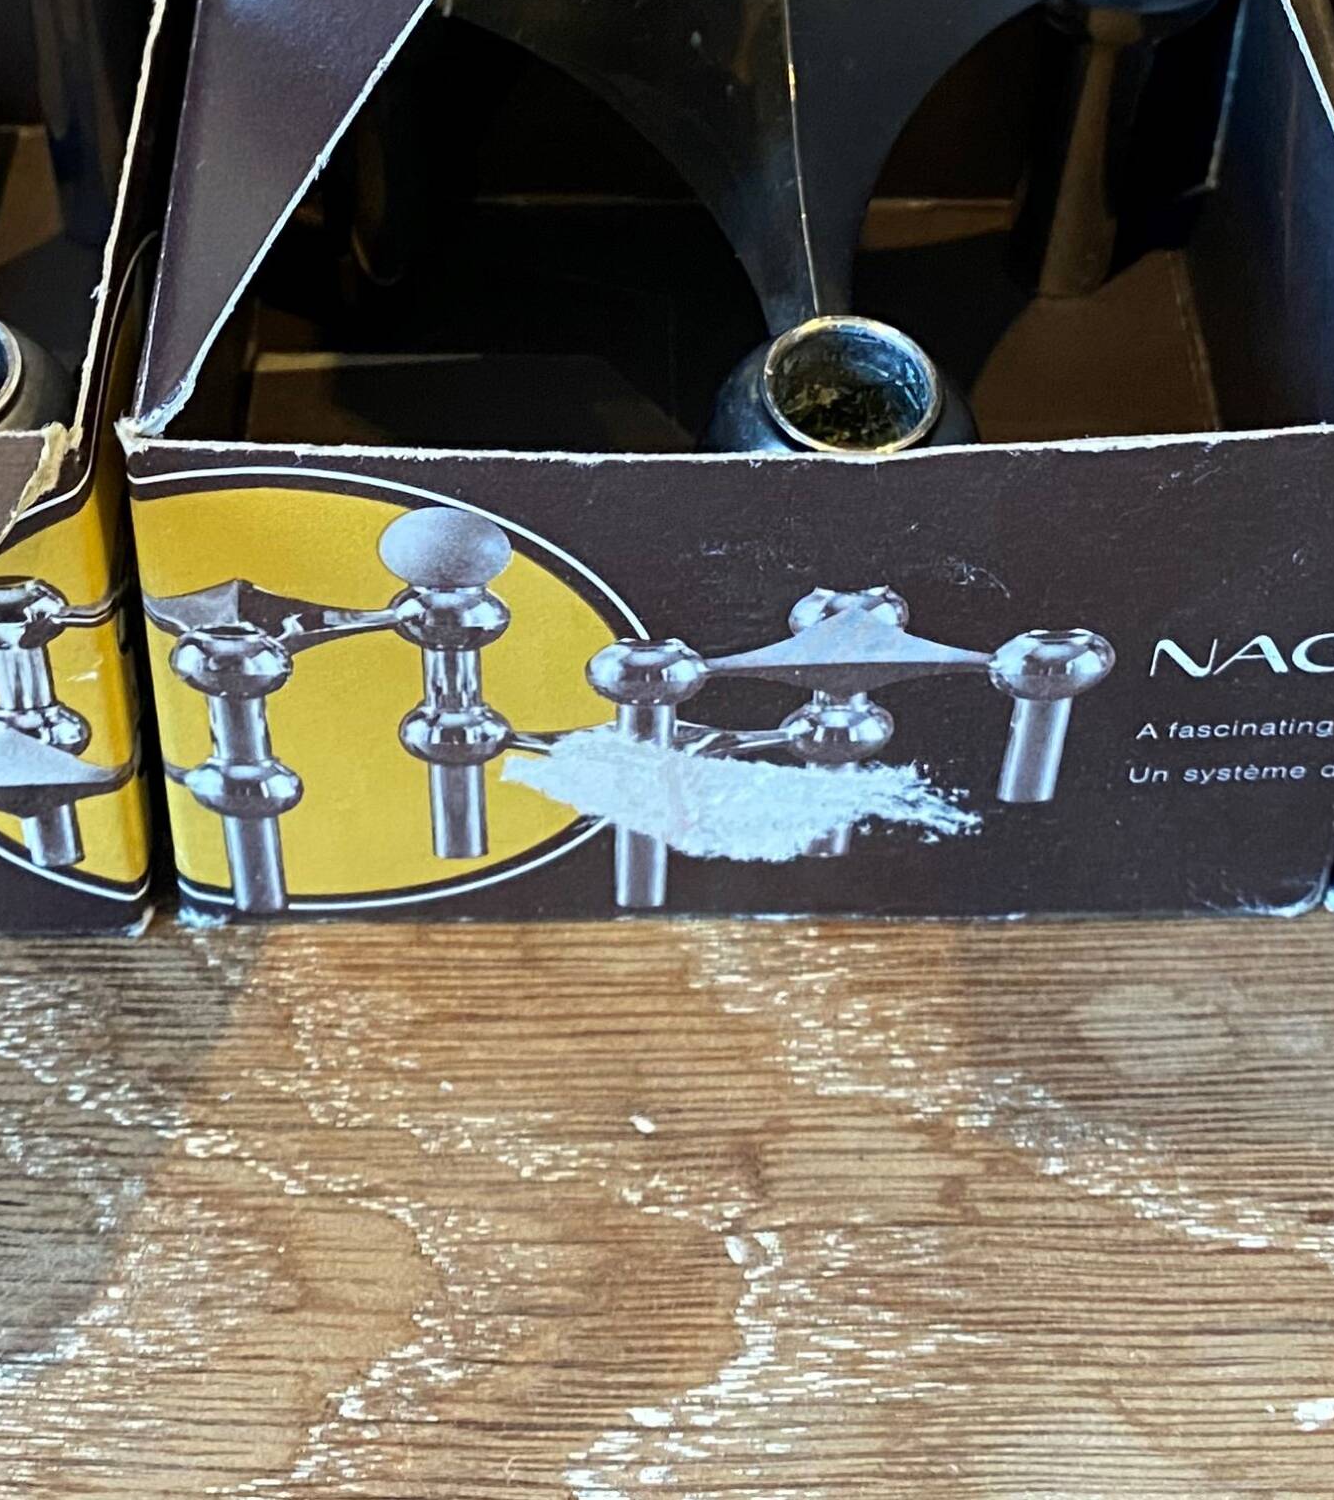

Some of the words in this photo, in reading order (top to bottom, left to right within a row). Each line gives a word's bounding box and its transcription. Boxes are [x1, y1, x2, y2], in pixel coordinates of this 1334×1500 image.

[1135, 721, 1159, 741] A
[1127, 765, 1169, 785] Un
[1182, 762, 1308, 786] système
